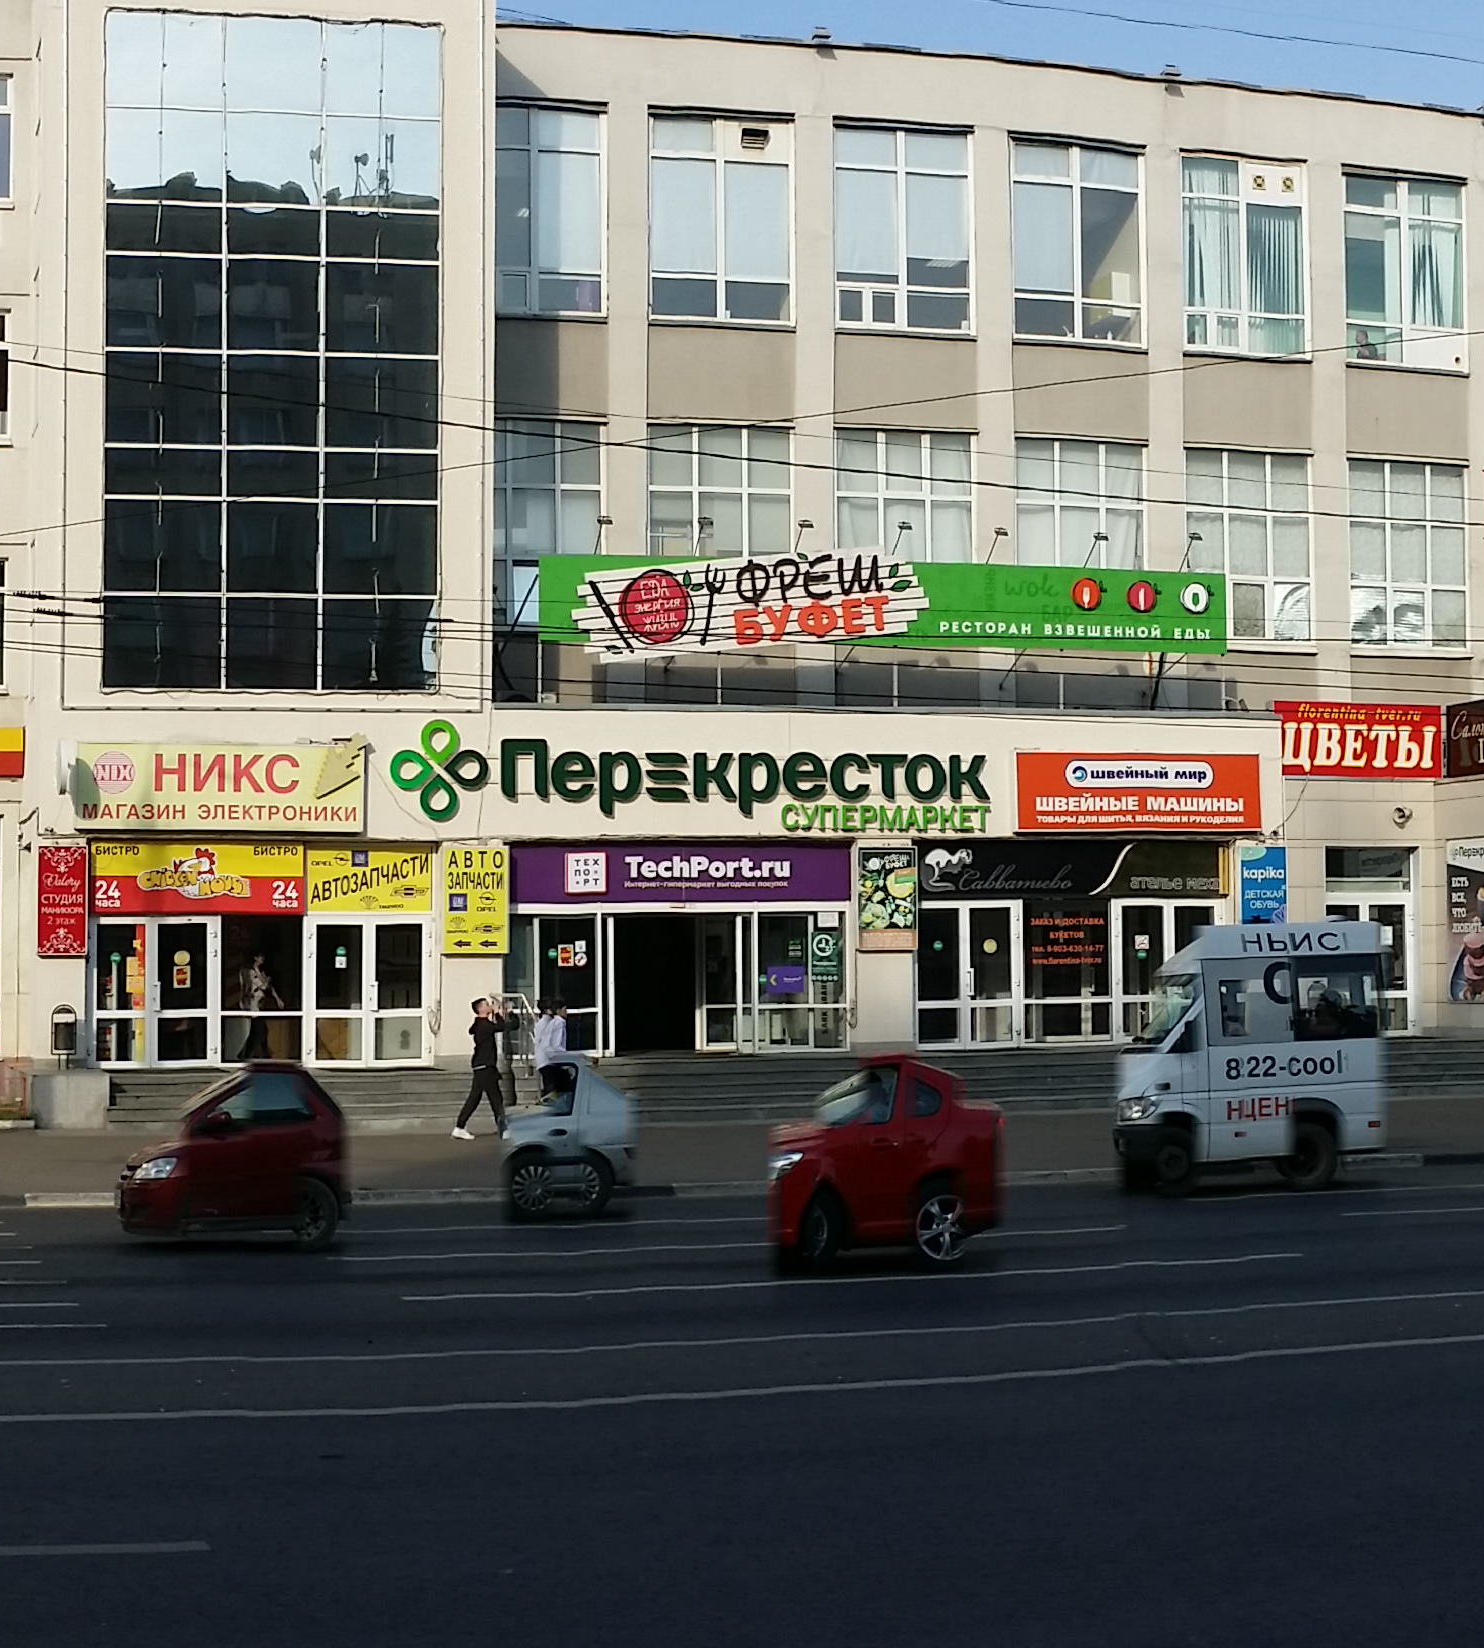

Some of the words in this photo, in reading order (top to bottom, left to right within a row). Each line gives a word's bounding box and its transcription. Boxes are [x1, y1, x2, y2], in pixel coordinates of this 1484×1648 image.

[736, 554, 884, 606] ФРЕШ
[734, 596, 889, 645] БУФЕТ
[940, 621, 1032, 636] РЕСТОРАН
[1044, 621, 1161, 639] ВЗВЕШЕННОЙ
[1174, 628, 1211, 640] ЕДЫ
[1282, 721, 1438, 773] ЦВЕТЫ
[153, 753, 301, 795] НИКС
[1090, 766, 1169, 780] швейный
[1174, 769, 1207, 784] мир
[1035, 792, 1140, 812] ШВЕЙНЫЕ
[1146, 797, 1245, 812] МАШИНЫ
[82, 803, 187, 821] МАГАЗИН
[197, 805, 358, 823] ЭЛЕКТРОНИКИ
[780, 803, 992, 833] СУПЕРМАРКЕТ
[1036, 815, 1076, 823] ТОВАРЫ
[1077, 816, 1097, 824] ДЛЯ
[1135, 815, 1181, 823] ВЯЗАНИЯ
[1189, 816, 1244, 825] РУКОДЕЛИЯ
[95, 846, 140, 857] БИСТРО
[253, 846, 298, 857] БИСТРО
[574, 858, 600, 867] ТЕХ
[624, 855, 791, 879] TechPort.ru
[310, 853, 430, 905] АВТОЗАПЧАСТИ
[1242, 865, 1285, 882] kapika
[447, 872, 504, 890] ЗАПЧАСТИ
[716, 881, 756, 889] выгодных
[757, 881, 789, 890] покупок
[1130, 877, 1183, 891] ателье
[1451, 876, 1469, 888] ЕСТЬ
[95, 880, 121, 900] 24
[272, 880, 299, 900] 24
[1244, 889, 1285, 900] ДЕТСКАЯ
[41, 893, 84, 906] СТУДИЯ
[95, 899, 121, 909] часа
[272, 899, 299, 909] часа
[1249, 899, 1280, 909] ОБУВЬ
[41, 906, 84, 915] МАНИКЮРА
[1451, 907, 1467, 918] ЧТО
[47, 917, 53, 926] 2
[54, 916, 76, 926] этаж
[1030, 917, 1054, 926] ЗАКАЗ
[1062, 917, 1104, 927] ДОСТАВКА
